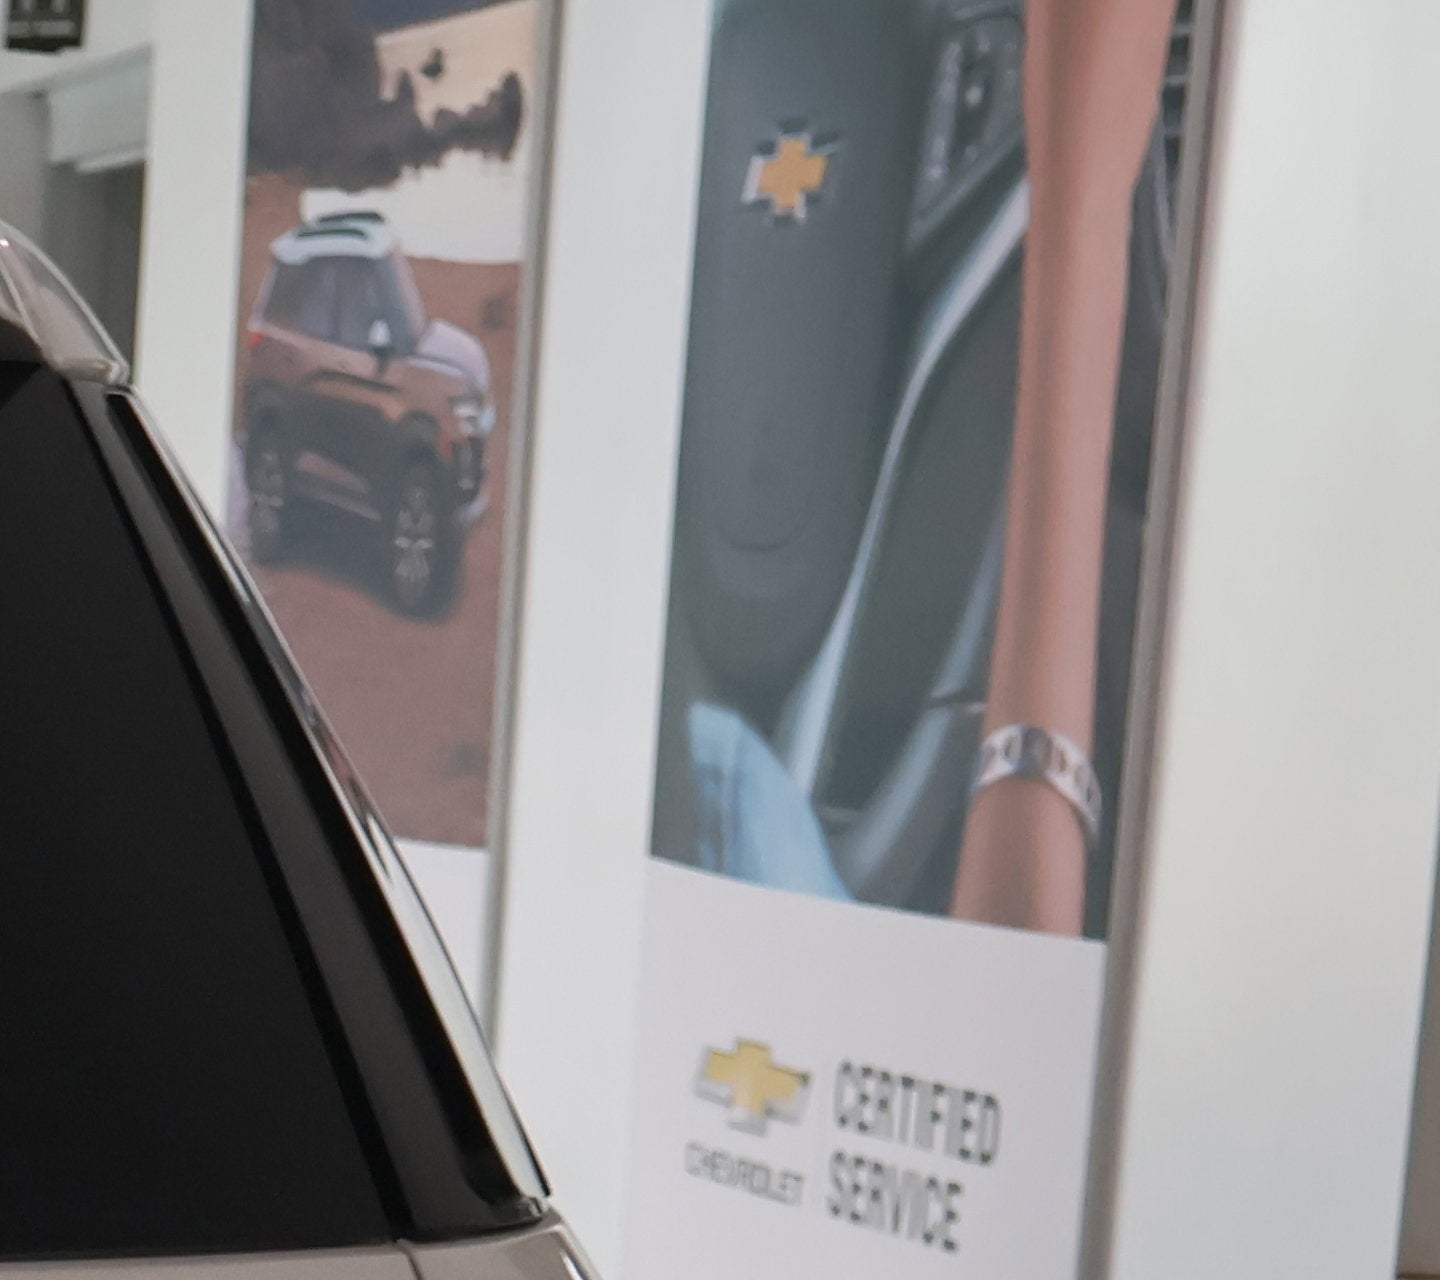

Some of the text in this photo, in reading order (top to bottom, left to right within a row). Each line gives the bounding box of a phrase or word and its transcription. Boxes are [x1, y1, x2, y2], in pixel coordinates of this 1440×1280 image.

[832, 1057, 1002, 1166] CERTIFIED
[683, 1140, 805, 1206] CHEVROLET
[826, 1148, 965, 1254] SERVICE
